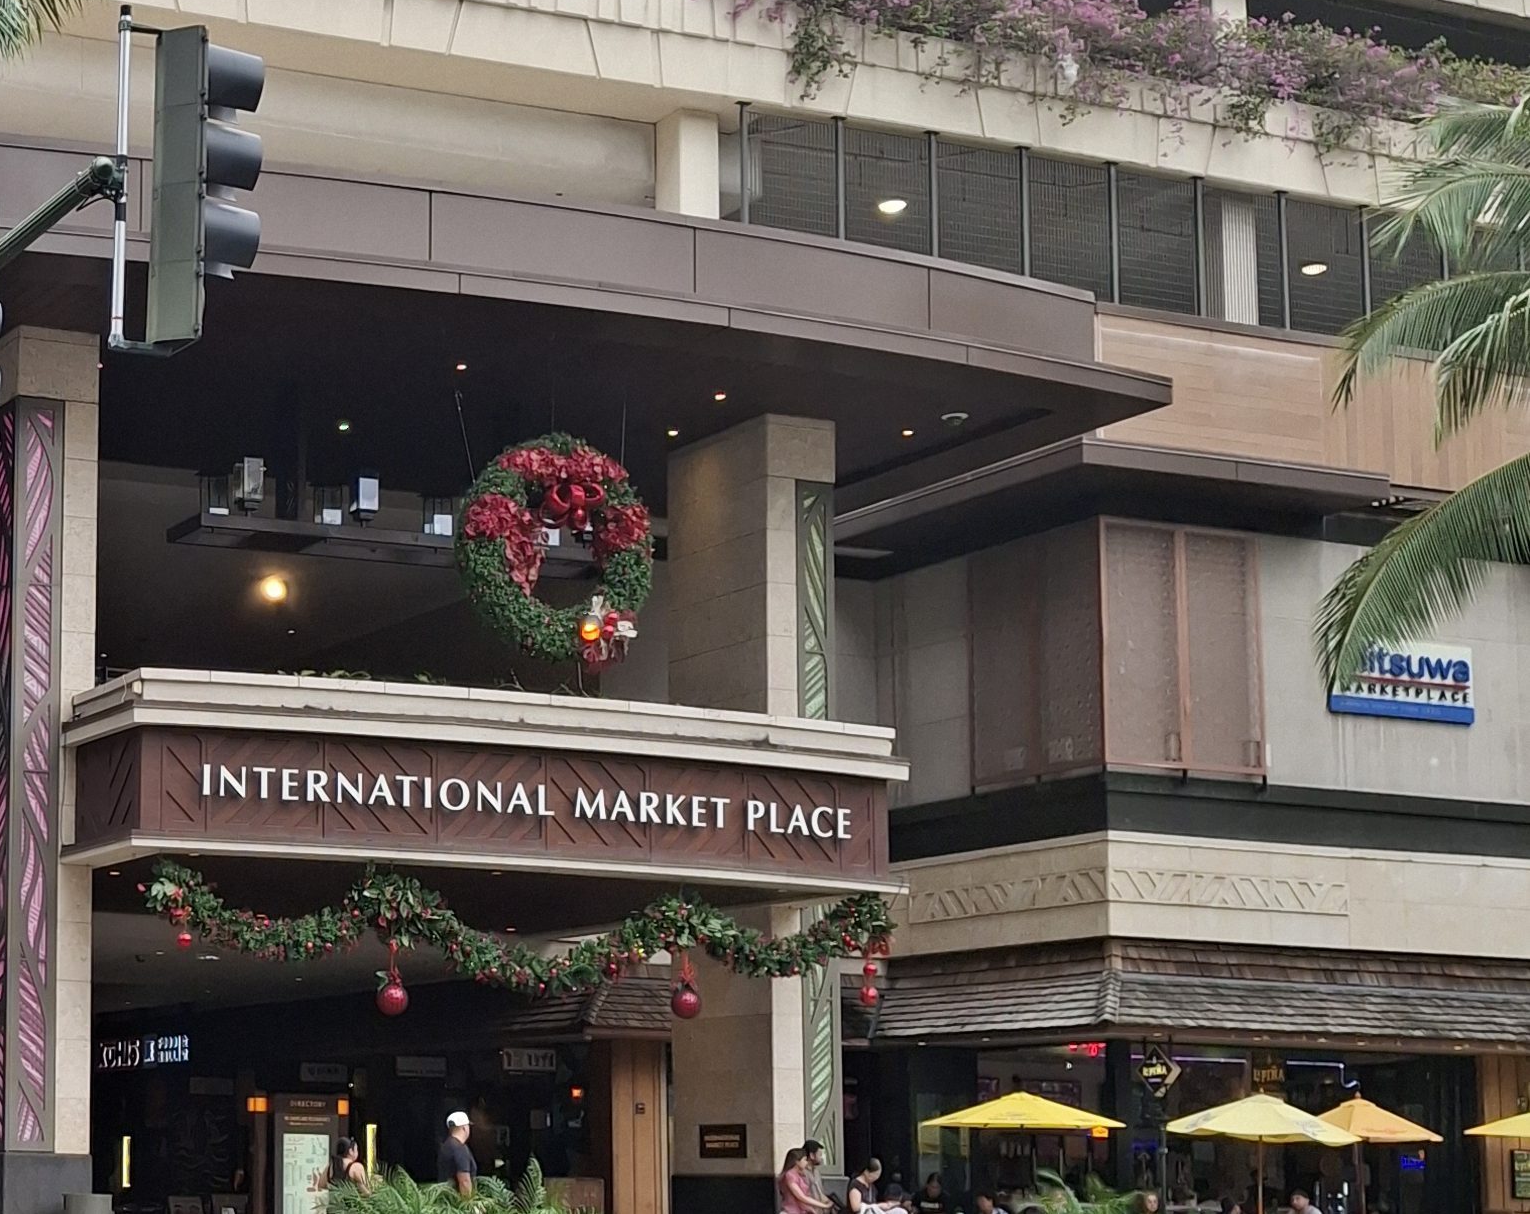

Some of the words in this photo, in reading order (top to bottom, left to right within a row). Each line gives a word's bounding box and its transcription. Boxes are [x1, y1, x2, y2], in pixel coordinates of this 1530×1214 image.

[1360, 643, 1469, 683] itsuwa
[201, 763, 555, 817] INTERNATIONAL
[574, 787, 730, 829] MARKET
[747, 801, 852, 839] PLACE
